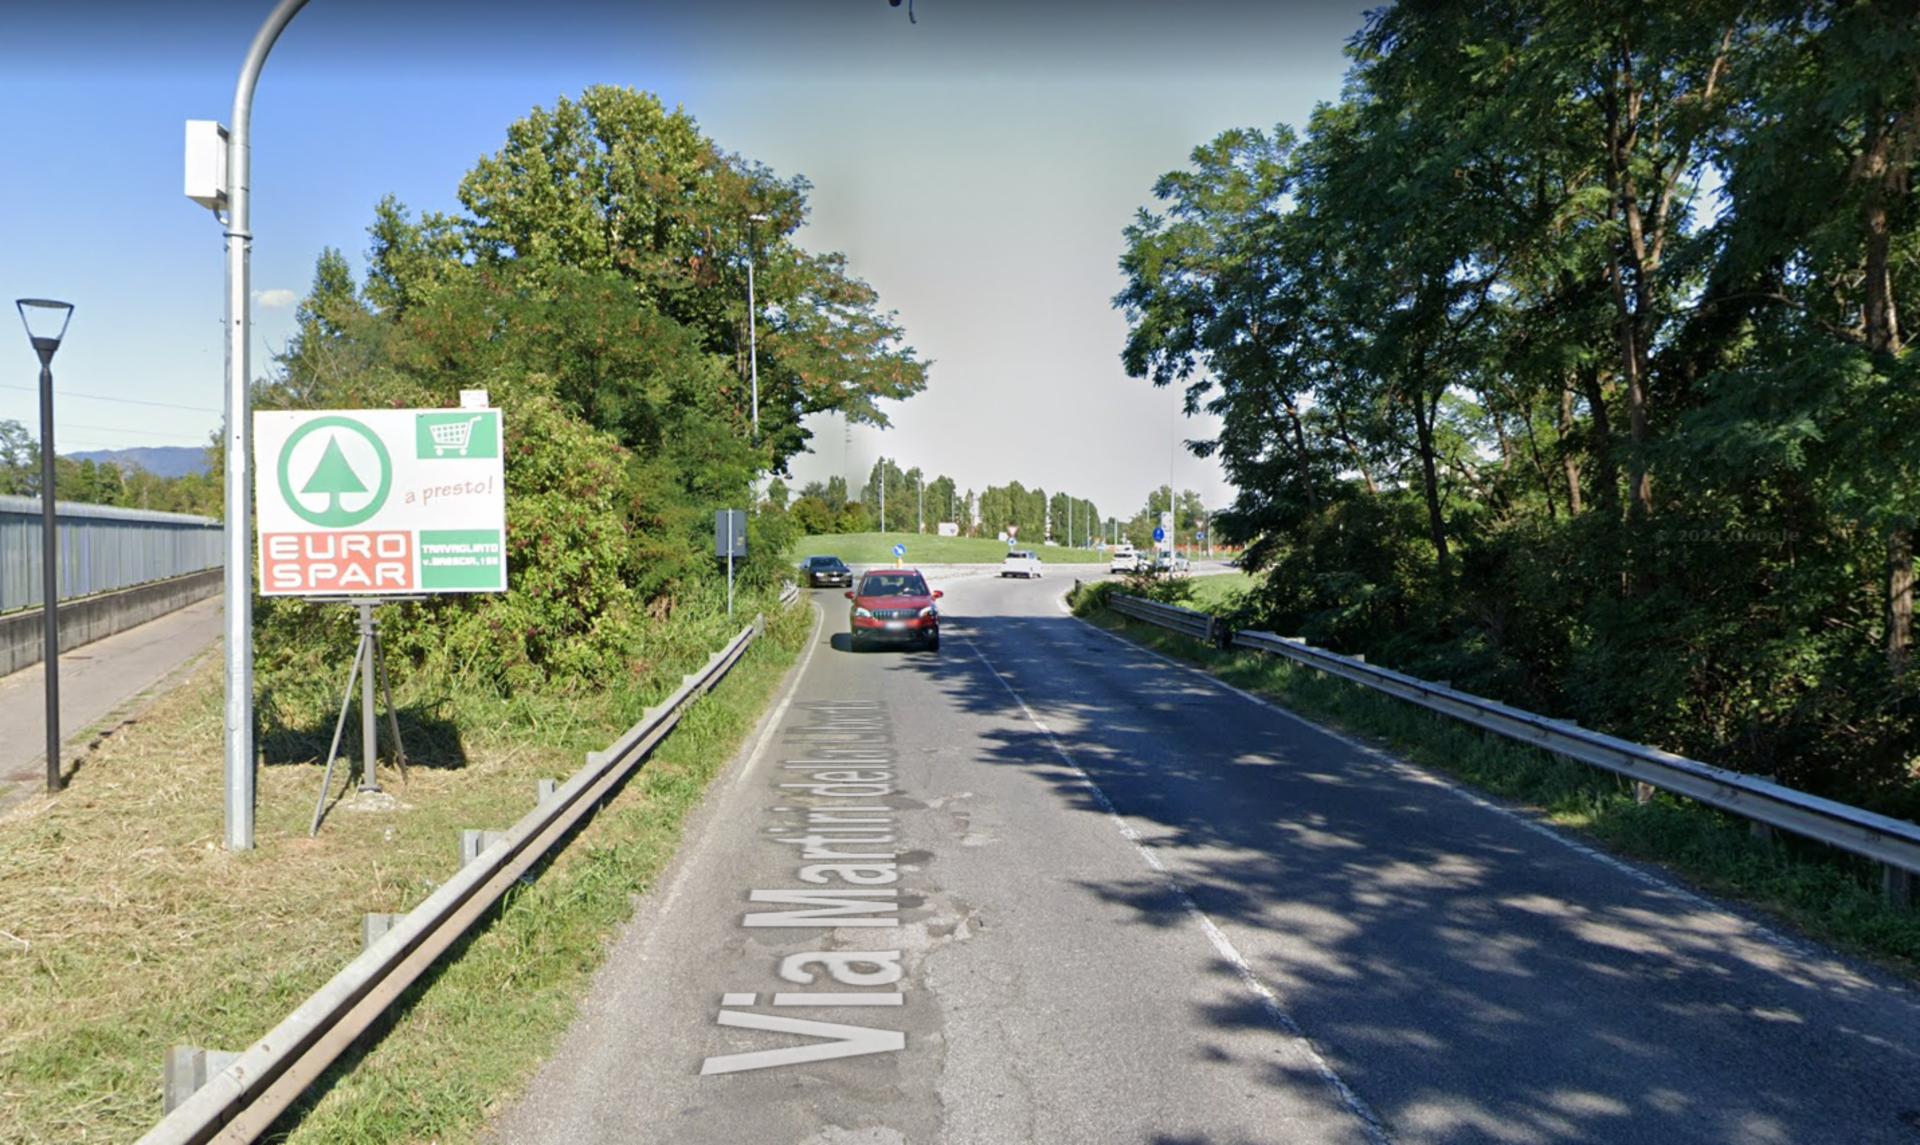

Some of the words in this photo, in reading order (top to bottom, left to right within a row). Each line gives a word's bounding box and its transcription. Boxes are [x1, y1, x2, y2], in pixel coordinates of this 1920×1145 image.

[405, 490, 416, 504] a
[422, 475, 495, 506] presto!
[268, 533, 407, 561] EURO
[271, 561, 407, 588] SPAR
